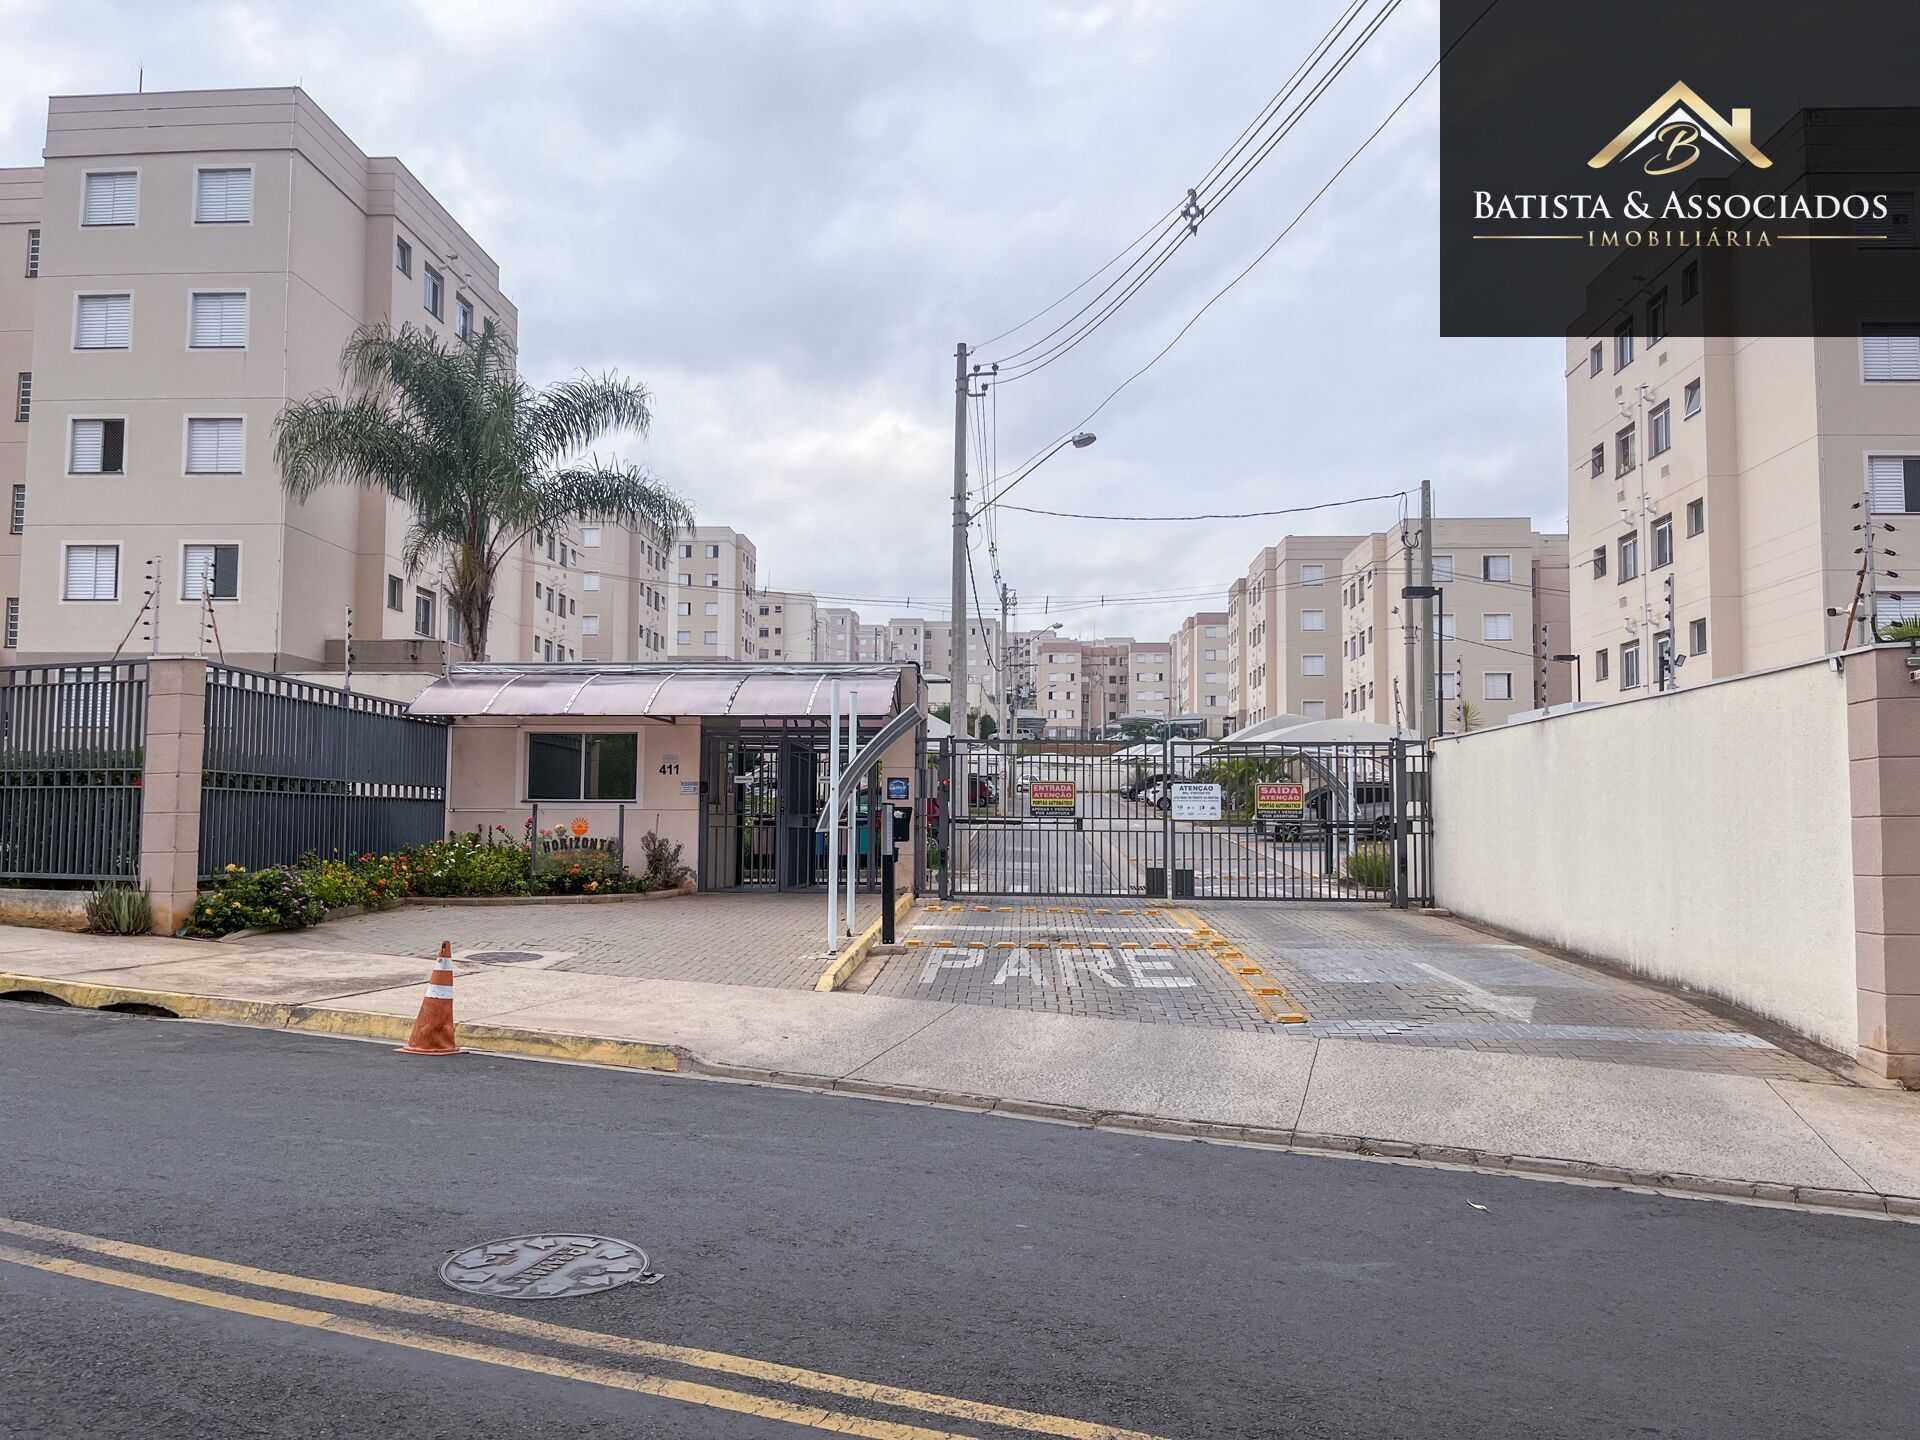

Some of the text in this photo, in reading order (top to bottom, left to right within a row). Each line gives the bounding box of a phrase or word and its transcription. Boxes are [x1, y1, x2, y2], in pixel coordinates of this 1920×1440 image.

[658, 763, 680, 775] 411
[1260, 786, 1299, 794] SAÍDA
[542, 837, 615, 853] HORIZONTE
[918, 948, 1197, 988] PARE
